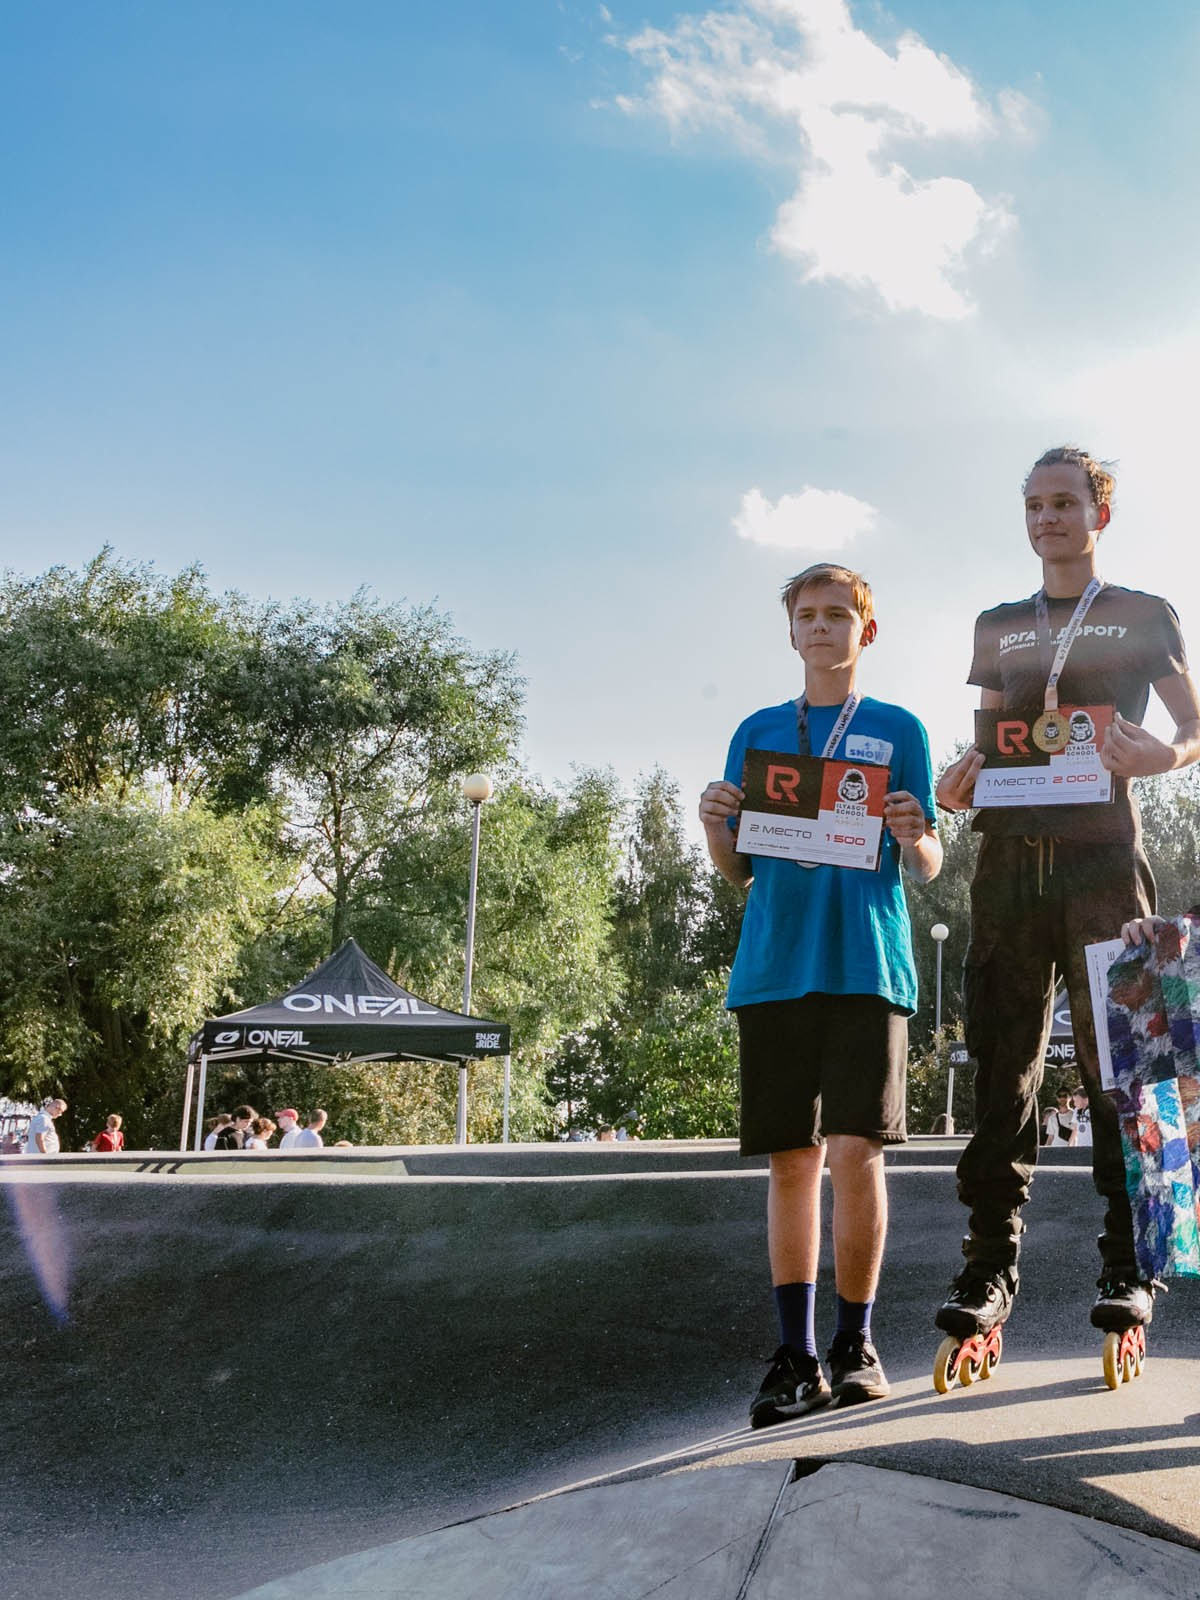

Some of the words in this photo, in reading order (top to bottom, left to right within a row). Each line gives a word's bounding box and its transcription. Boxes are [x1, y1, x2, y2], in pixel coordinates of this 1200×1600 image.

[1052, 776, 1063, 784] 2
[1066, 774, 1098, 783] 000
[836, 803, 866, 811] ILYASOV
[836, 809, 865, 817] SCHOOL
[749, 824, 760, 833] 2
[834, 835, 866, 846] 500
[476, 1033, 501, 1041] ENJOY
